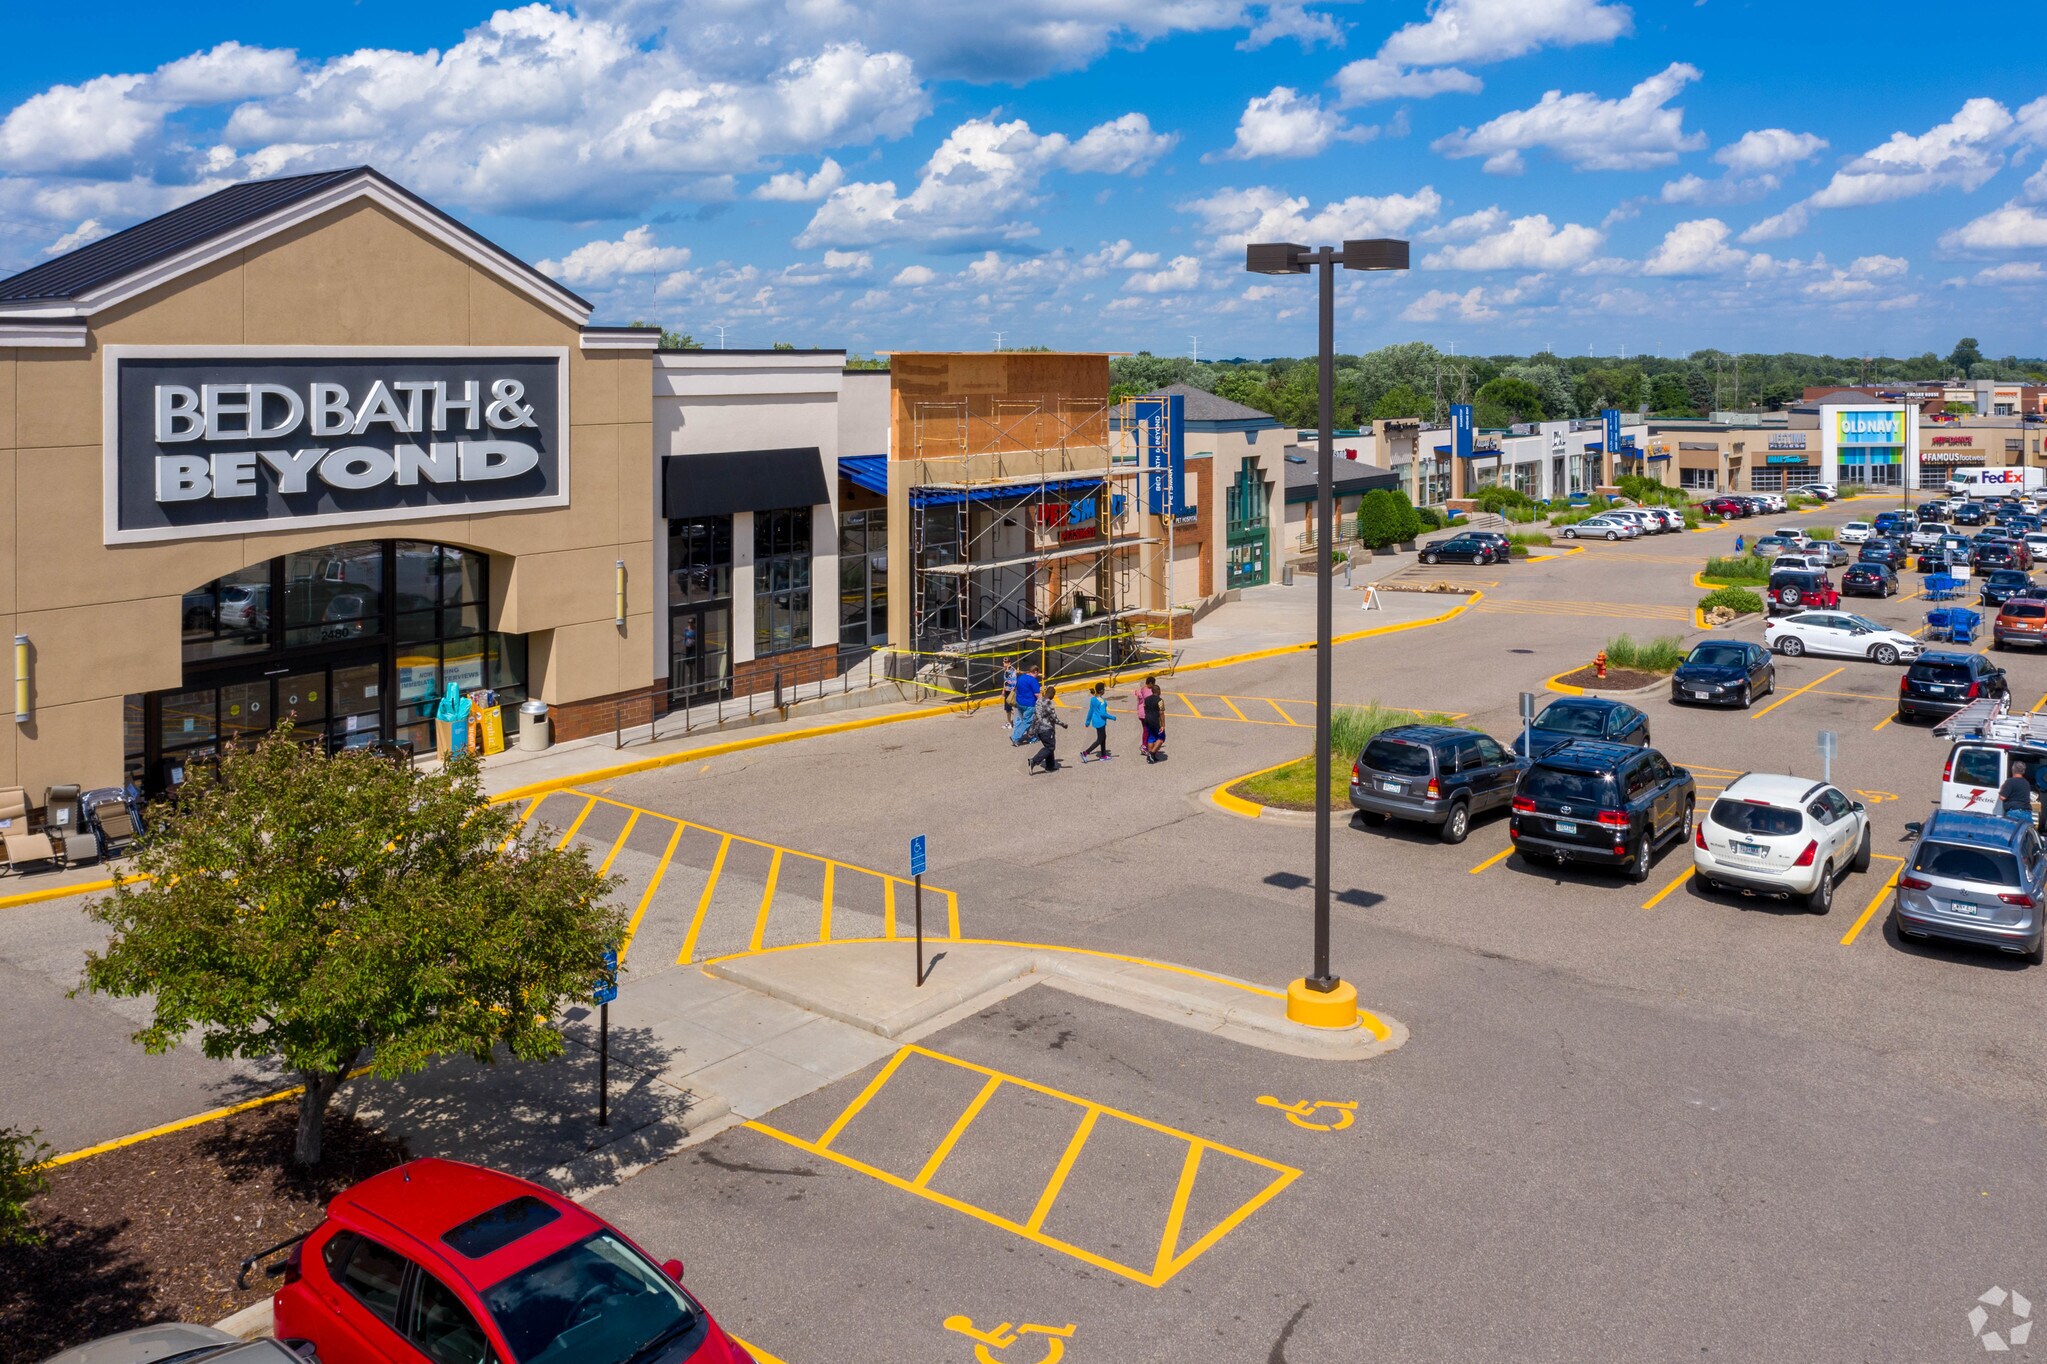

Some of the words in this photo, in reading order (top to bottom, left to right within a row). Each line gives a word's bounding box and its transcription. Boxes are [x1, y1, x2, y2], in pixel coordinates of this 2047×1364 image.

[155, 382, 304, 443] BED
[310, 380, 481, 436] BATH
[484, 378, 539, 430] &
[1841, 420, 1868, 434] OLD
[1868, 420, 1901, 434] NAVY
[1927, 453, 1960, 462] FAMOUS
[155, 440, 539, 502] BEYOND
[1981, 470, 2024, 484] FedEx
[1037, 494, 1127, 527] PETSMRT
[321, 628, 350, 640] 2480
[418, 671, 434, 679] NOW
[444, 671, 480, 682] TERVIEWS
